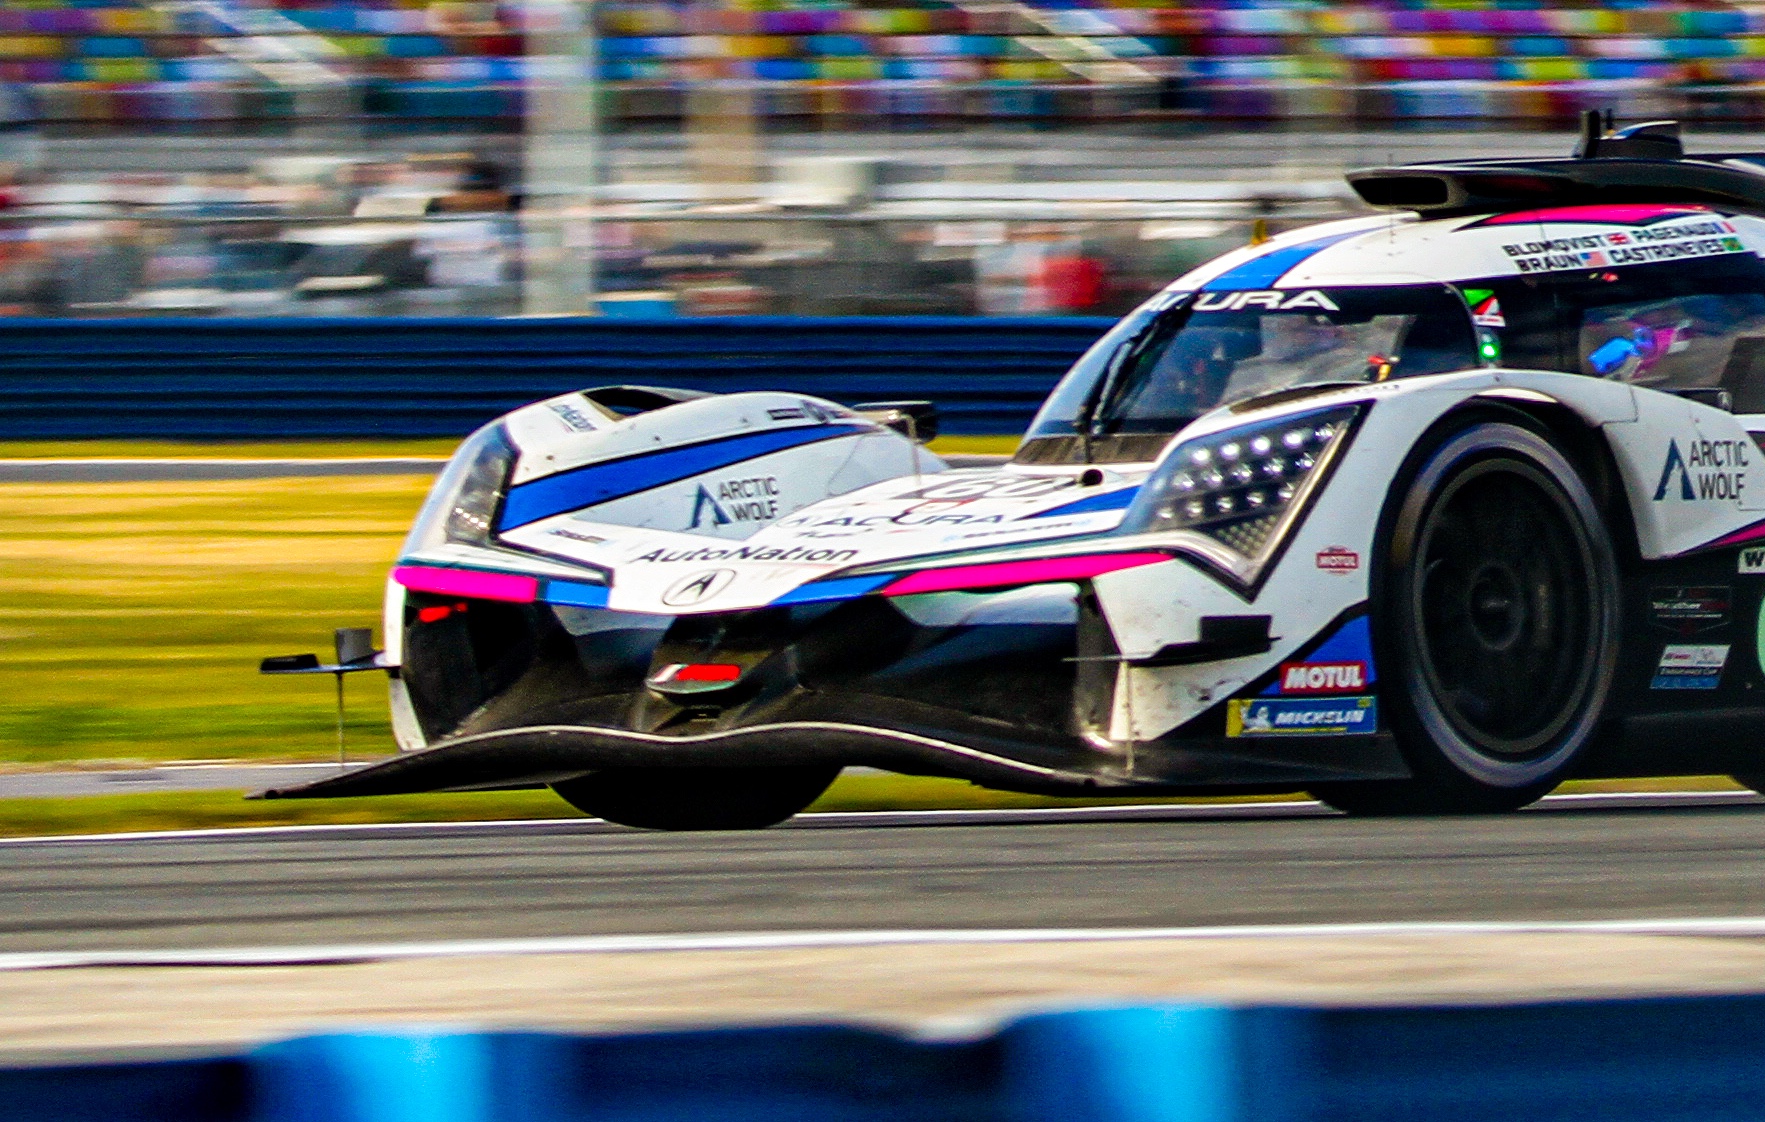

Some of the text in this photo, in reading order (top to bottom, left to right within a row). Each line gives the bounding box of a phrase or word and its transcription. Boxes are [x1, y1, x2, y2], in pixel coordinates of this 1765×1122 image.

[1502, 222, 1717, 257] BLOMQVIST PAGENAUD
[1513, 238, 1724, 272] BRAUN CASTRONEVES
[1688, 440, 1750, 468] ARCTIC
[720, 476, 780, 500] ARCTIC
[1699, 472, 1745, 501] WOLF
[731, 499, 779, 521] WOLF
[812, 514, 1004, 527] ACURA
[627, 545, 859, 564] AutoNation
[1284, 665, 1364, 690] MOTUL
[1275, 709, 1366, 726] MICHELIN
